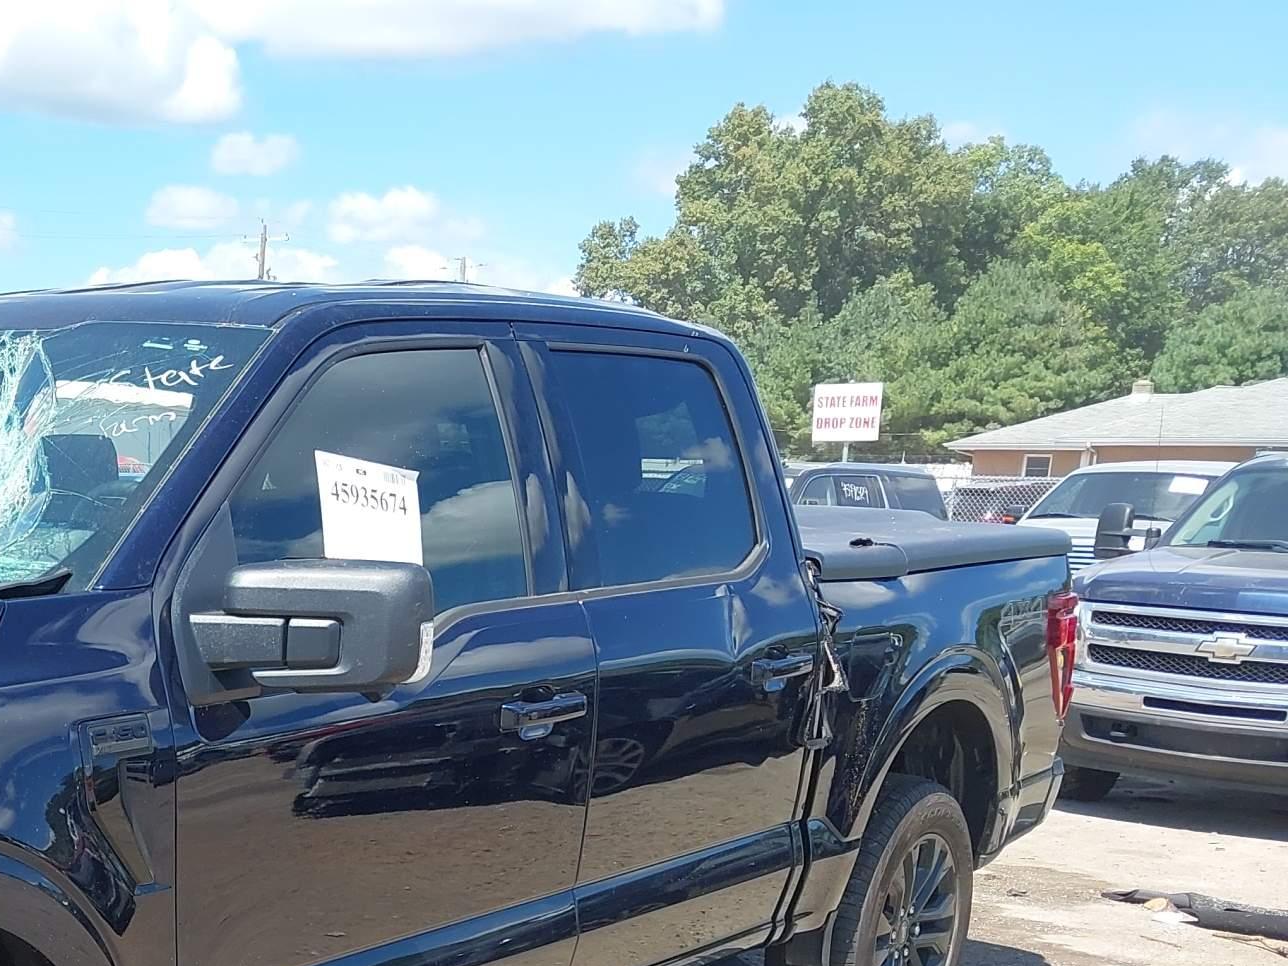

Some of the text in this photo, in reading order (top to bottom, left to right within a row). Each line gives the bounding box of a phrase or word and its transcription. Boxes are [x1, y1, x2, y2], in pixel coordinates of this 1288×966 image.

[817, 395, 878, 408] STATE FARM
[816, 416, 877, 429] DROP ZONE
[331, 480, 408, 516] 45935674
